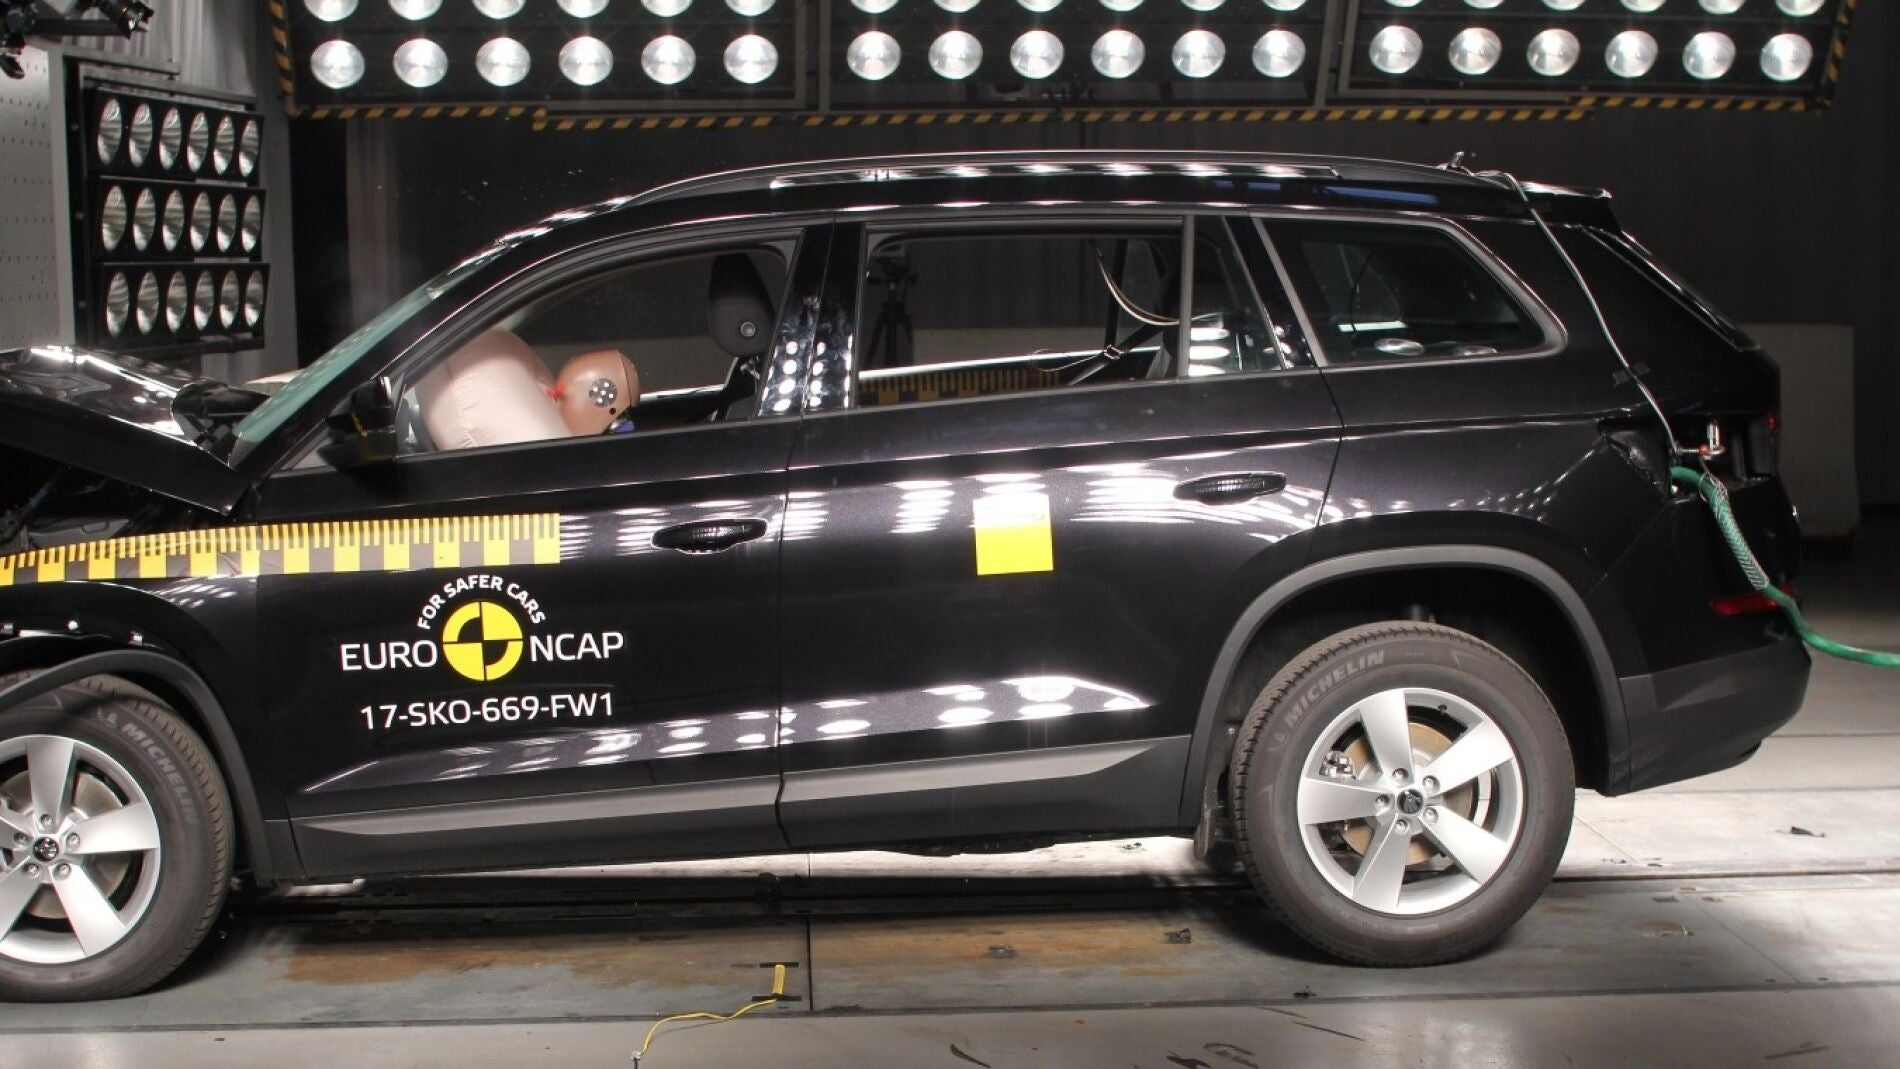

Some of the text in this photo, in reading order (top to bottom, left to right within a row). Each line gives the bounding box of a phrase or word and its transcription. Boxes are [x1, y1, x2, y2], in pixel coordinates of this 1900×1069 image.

[416, 574, 547, 630] FOR SAFER CARS
[340, 631, 624, 671] EURO NCAP
[360, 692, 613, 730] 17-SKO-669-FW1
[1283, 650, 1385, 727] MICHELIN
[121, 721, 199, 824] MICHELIN
